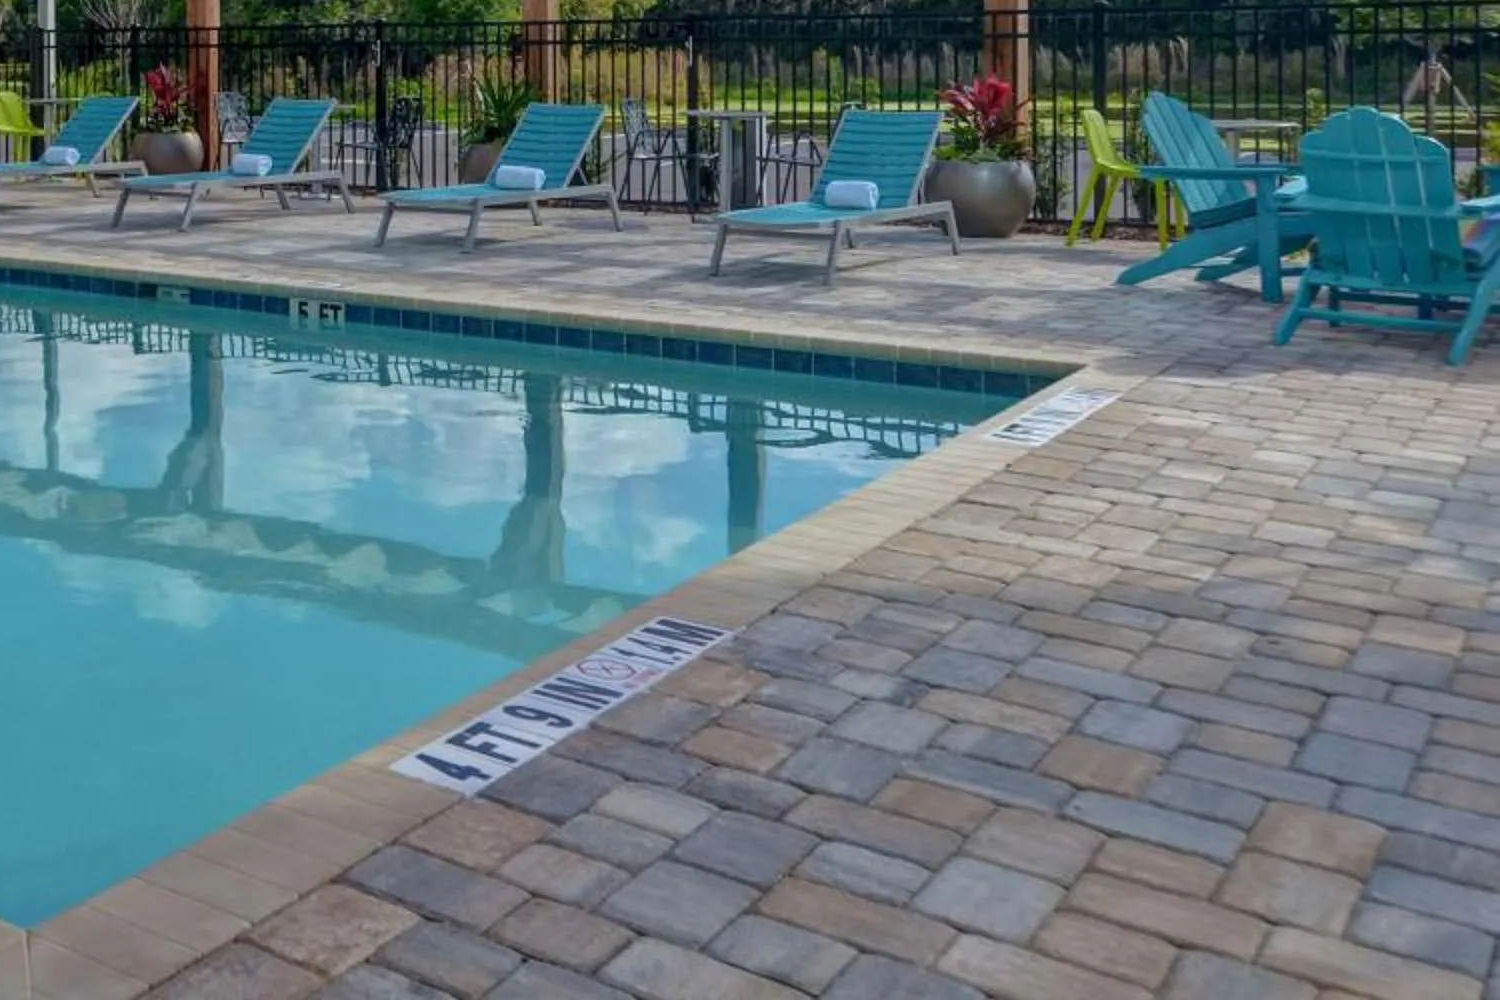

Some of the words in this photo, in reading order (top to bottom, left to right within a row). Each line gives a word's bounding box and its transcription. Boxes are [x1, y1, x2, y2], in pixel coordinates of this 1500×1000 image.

[299, 301, 309, 319] 5
[320, 303, 342, 322] FT
[532, 677, 624, 710] IN
[502, 705, 573, 728] 9
[445, 721, 542, 764] FT
[415, 753, 492, 780] 4
